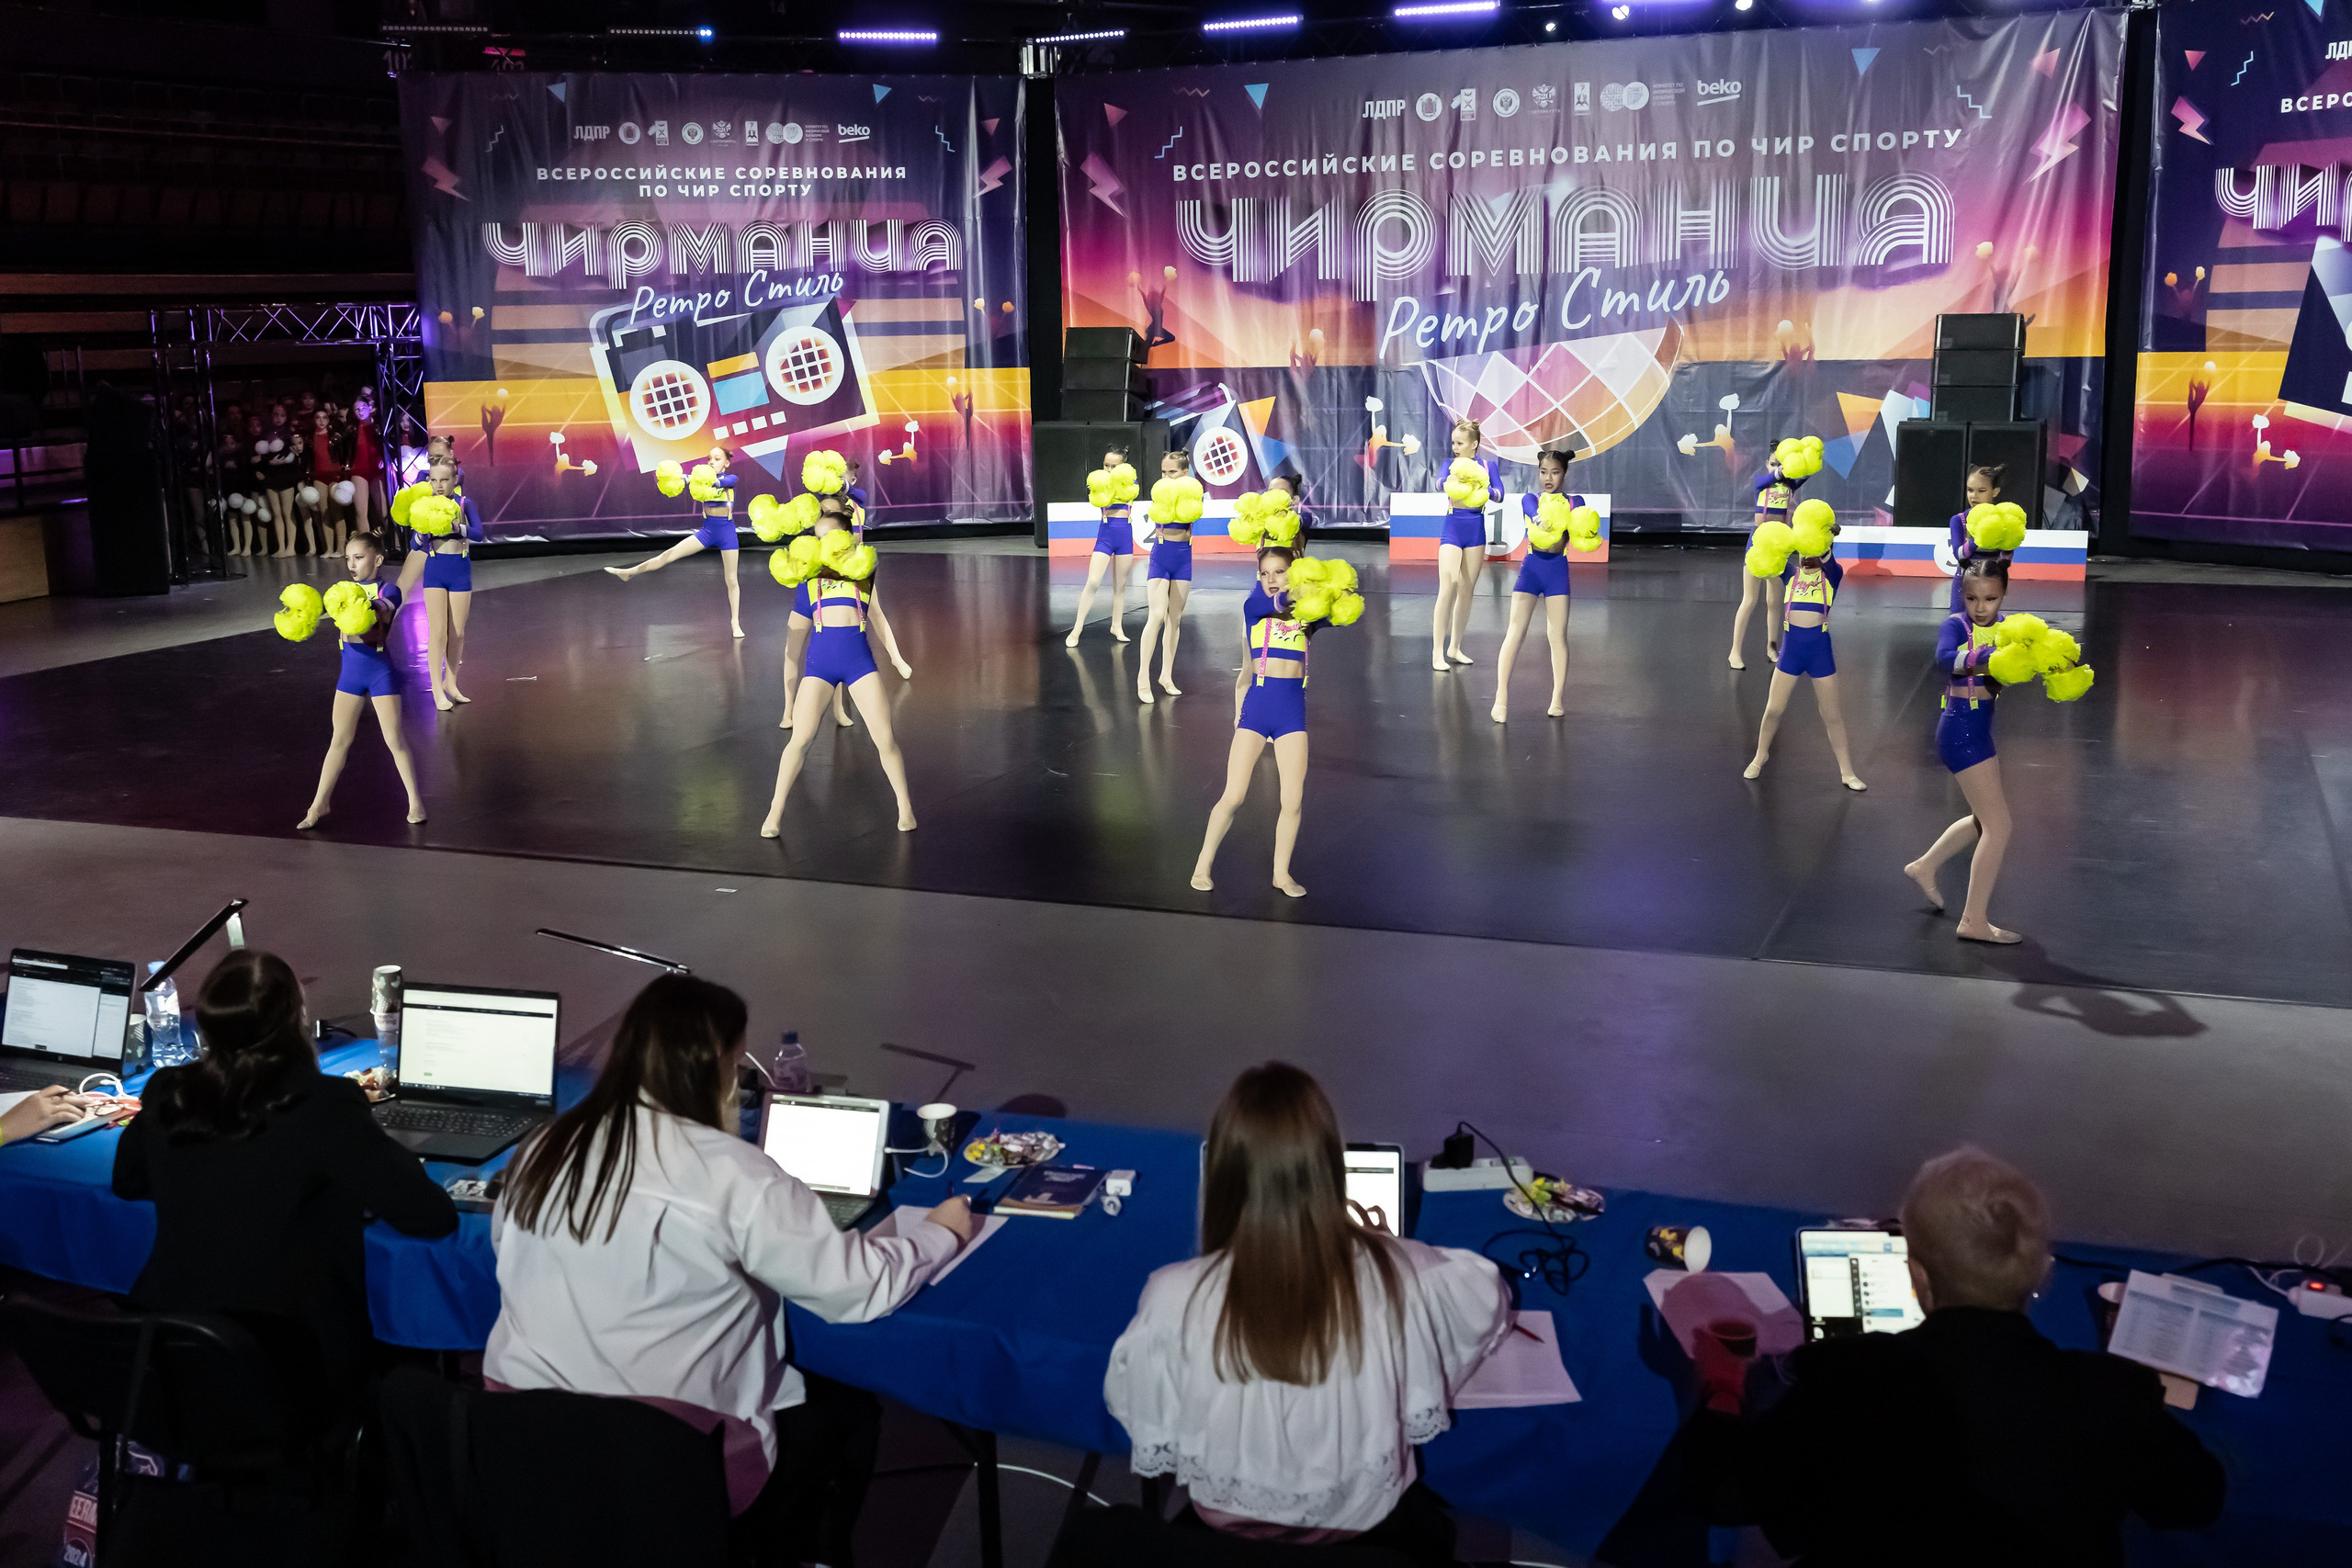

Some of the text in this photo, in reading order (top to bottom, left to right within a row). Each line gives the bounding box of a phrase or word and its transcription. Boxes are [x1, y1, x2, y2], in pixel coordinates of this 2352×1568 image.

[1697, 78, 1742, 95] beko
[1363, 99, 1406, 119] ЛДПР
[573, 125, 611, 141] ЛДПР
[837, 124, 871, 136] beko
[1173, 129, 1962, 181] ВСЕРОССИЙСКИЕ СОРЕВНОВАНИЯ ПО ЧИР СПОРТУ
[537, 164, 907, 181] ВСЕРОССИЙСКИЕ СОРЕВНОВАНИЯ
[639, 184, 812, 197] ПО ЧИР СПОРТУ
[2214, 160, 2352, 243] ЧИ
[629, 269, 844, 325] Ретро Стиль
[1378, 265, 1730, 359] Ретро Стиль
[1487, 509, 1508, 545] 1
